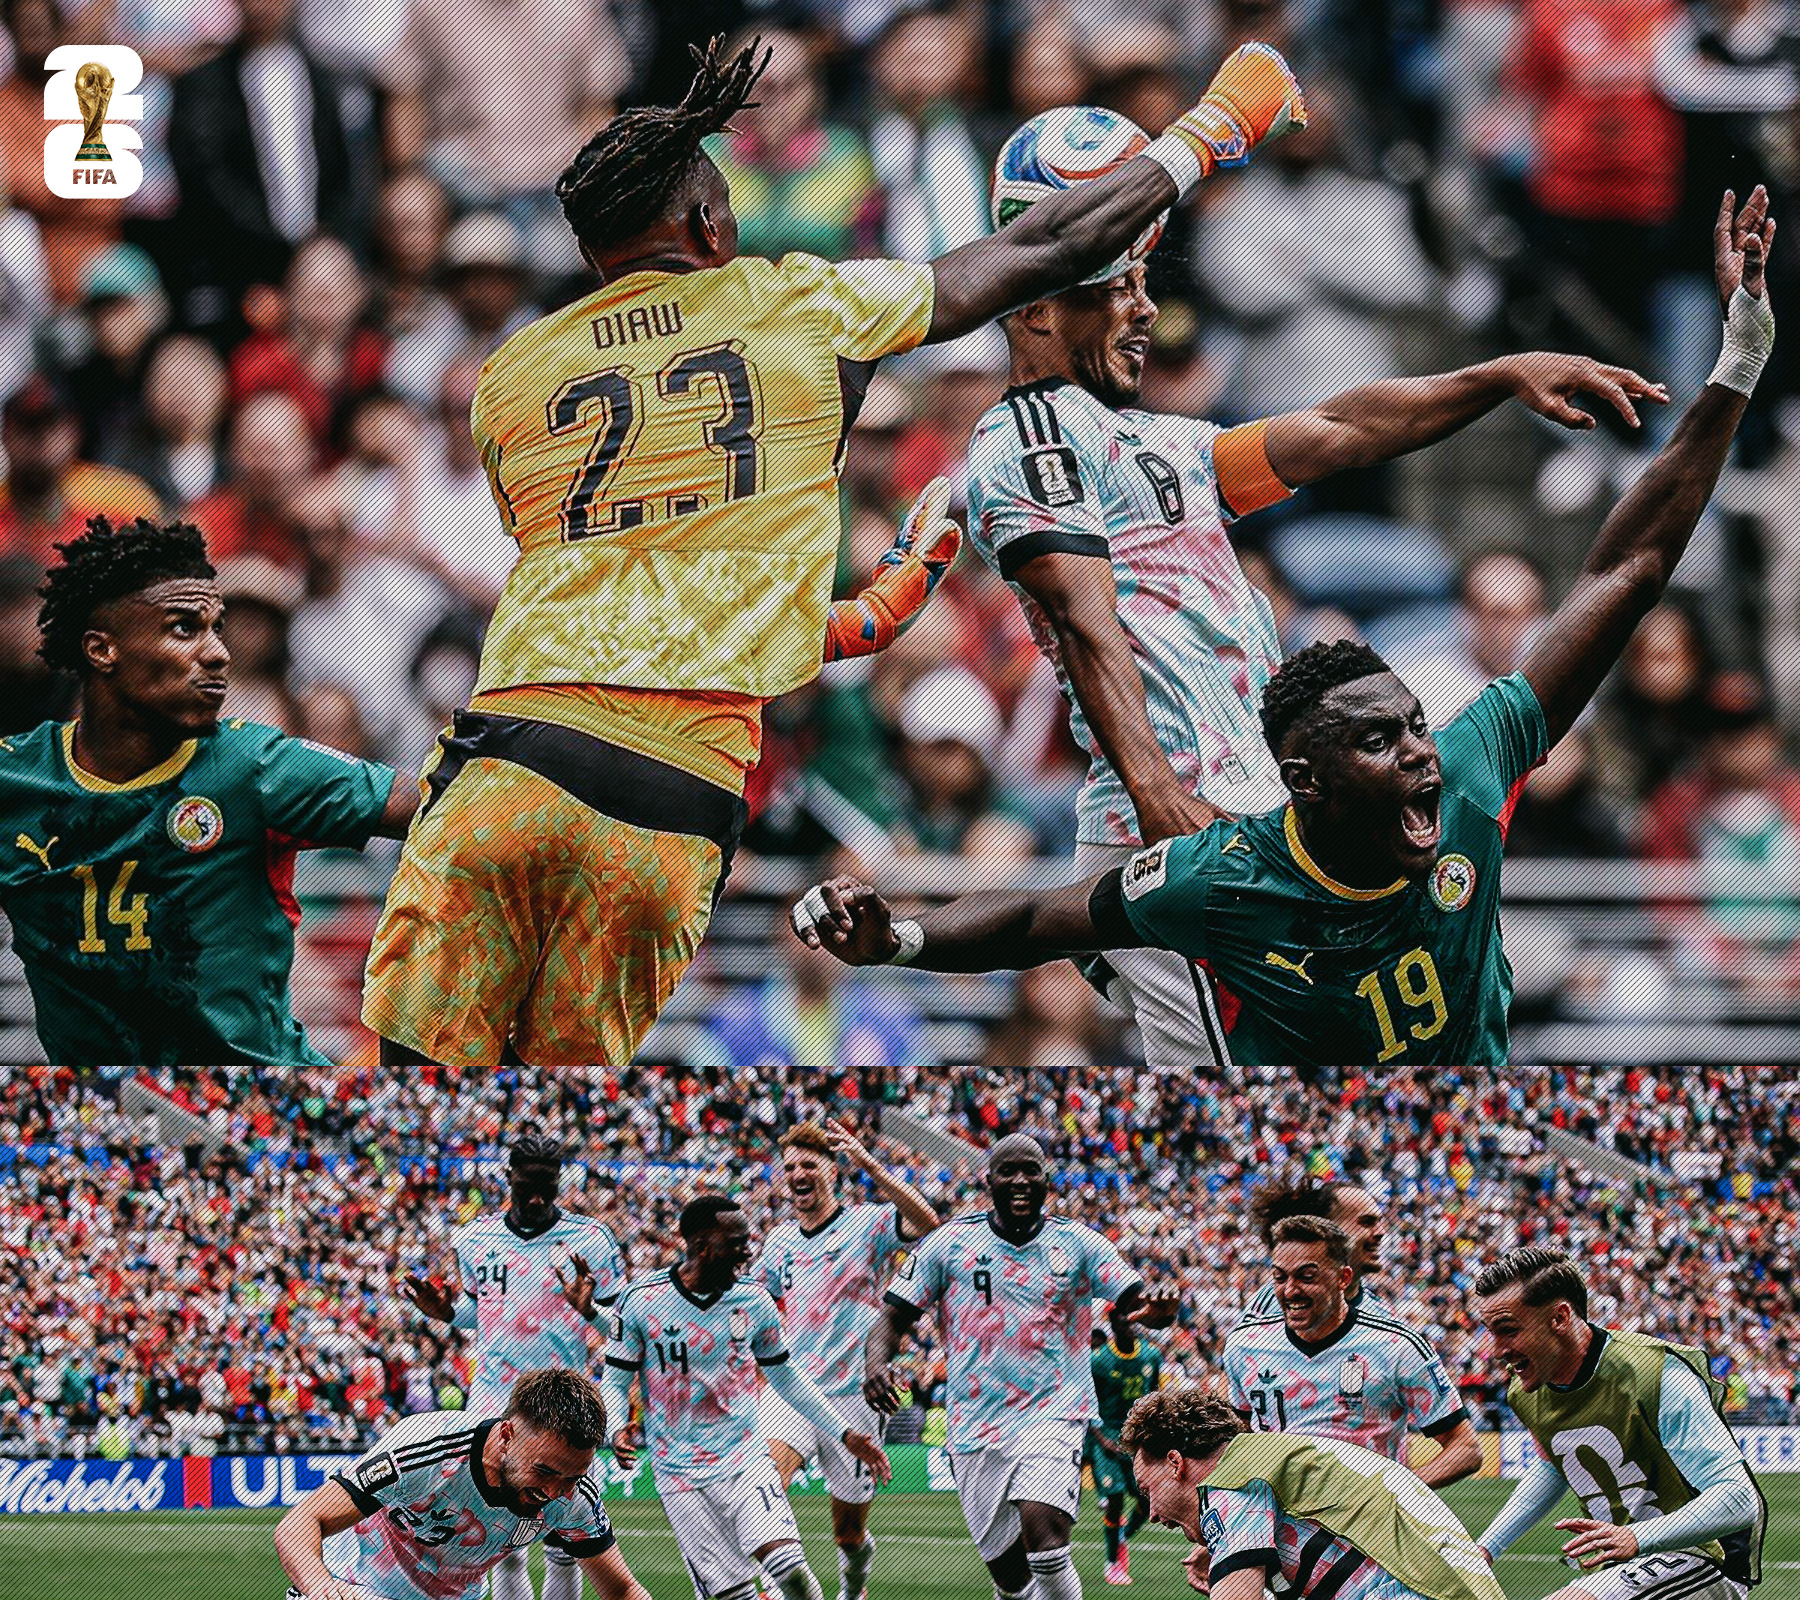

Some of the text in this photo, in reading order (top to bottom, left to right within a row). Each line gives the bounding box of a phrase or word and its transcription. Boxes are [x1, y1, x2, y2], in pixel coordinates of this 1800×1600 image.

[591, 302, 684, 350] DIAW
[546, 337, 767, 544] 23
[1135, 452, 1185, 525] 8
[70, 859, 152, 953] 14
[1354, 946, 1449, 1063] 19
[476, 1264, 508, 1296] 24
[973, 1270, 991, 1306] 9
[655, 1341, 689, 1375] 14
[1249, 1389, 1287, 1432] 21
